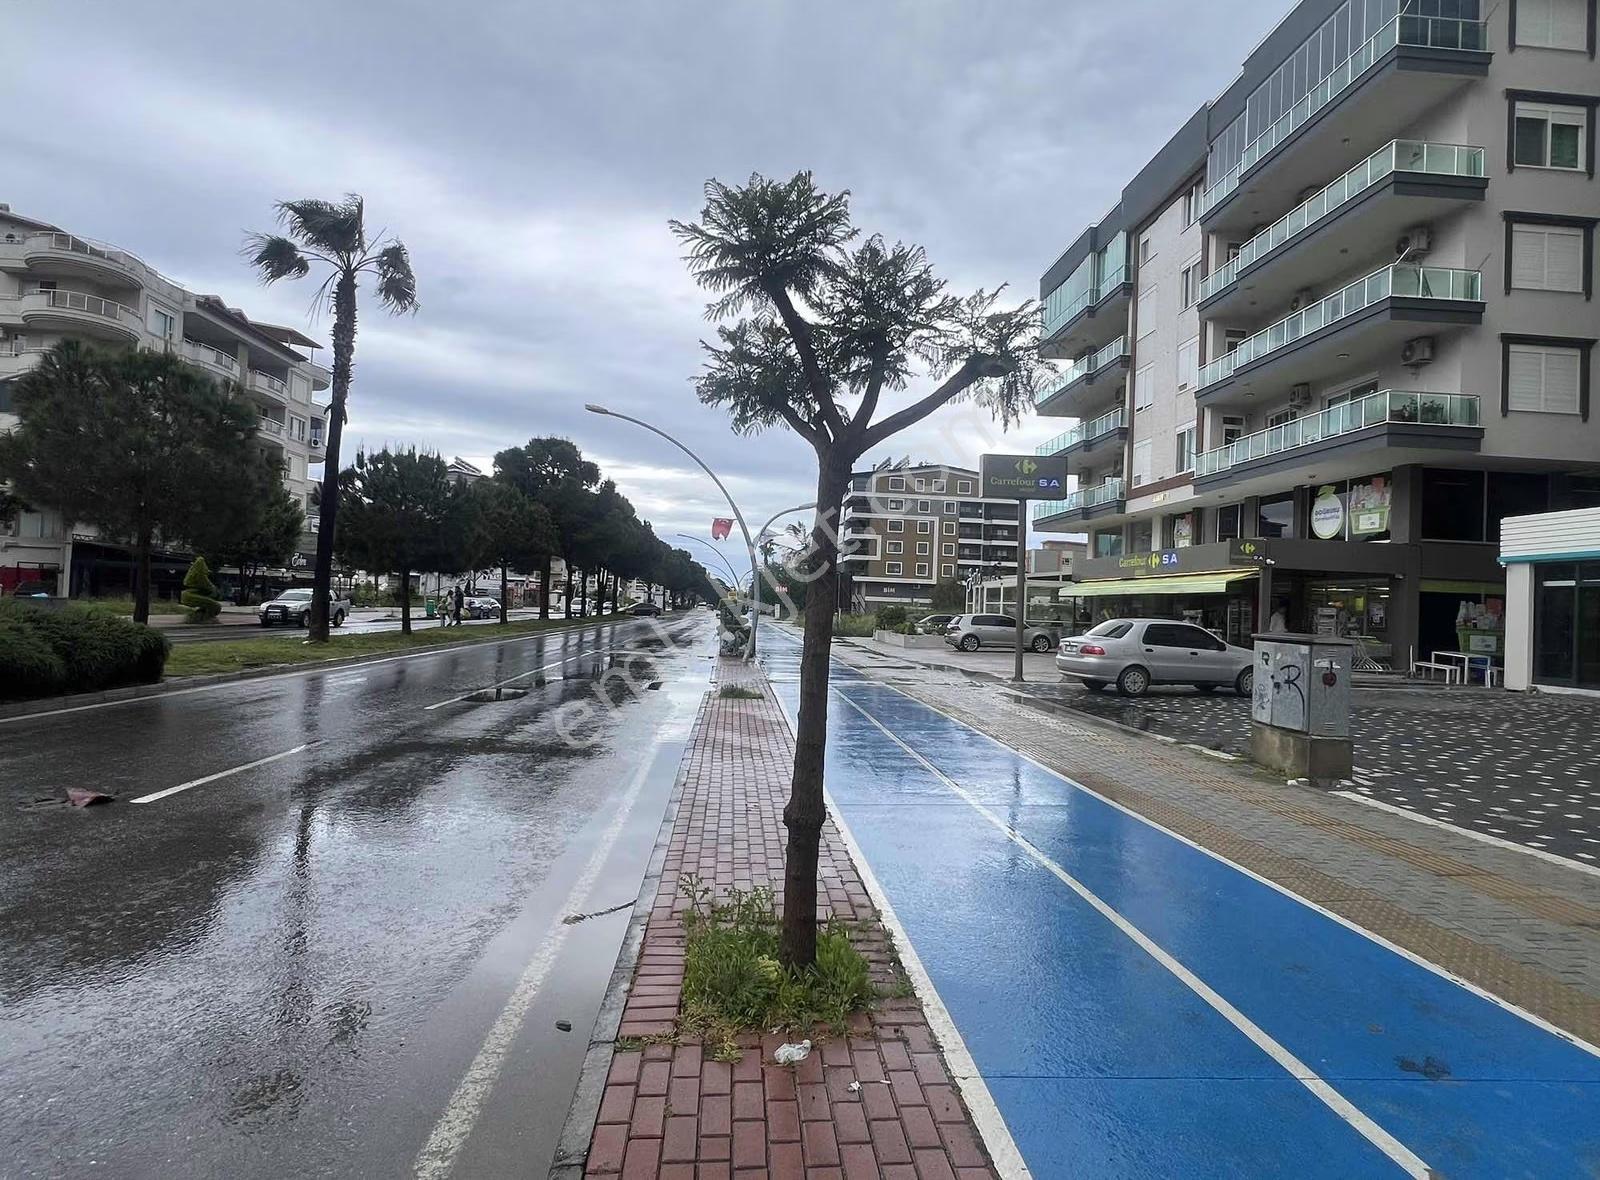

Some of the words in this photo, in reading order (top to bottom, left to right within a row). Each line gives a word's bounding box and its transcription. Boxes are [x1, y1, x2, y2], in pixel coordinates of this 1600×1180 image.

[990, 476, 1035, 488] Carrefour
[1039, 479, 1060, 488] SA
[1162, 554, 1178, 564] SA
